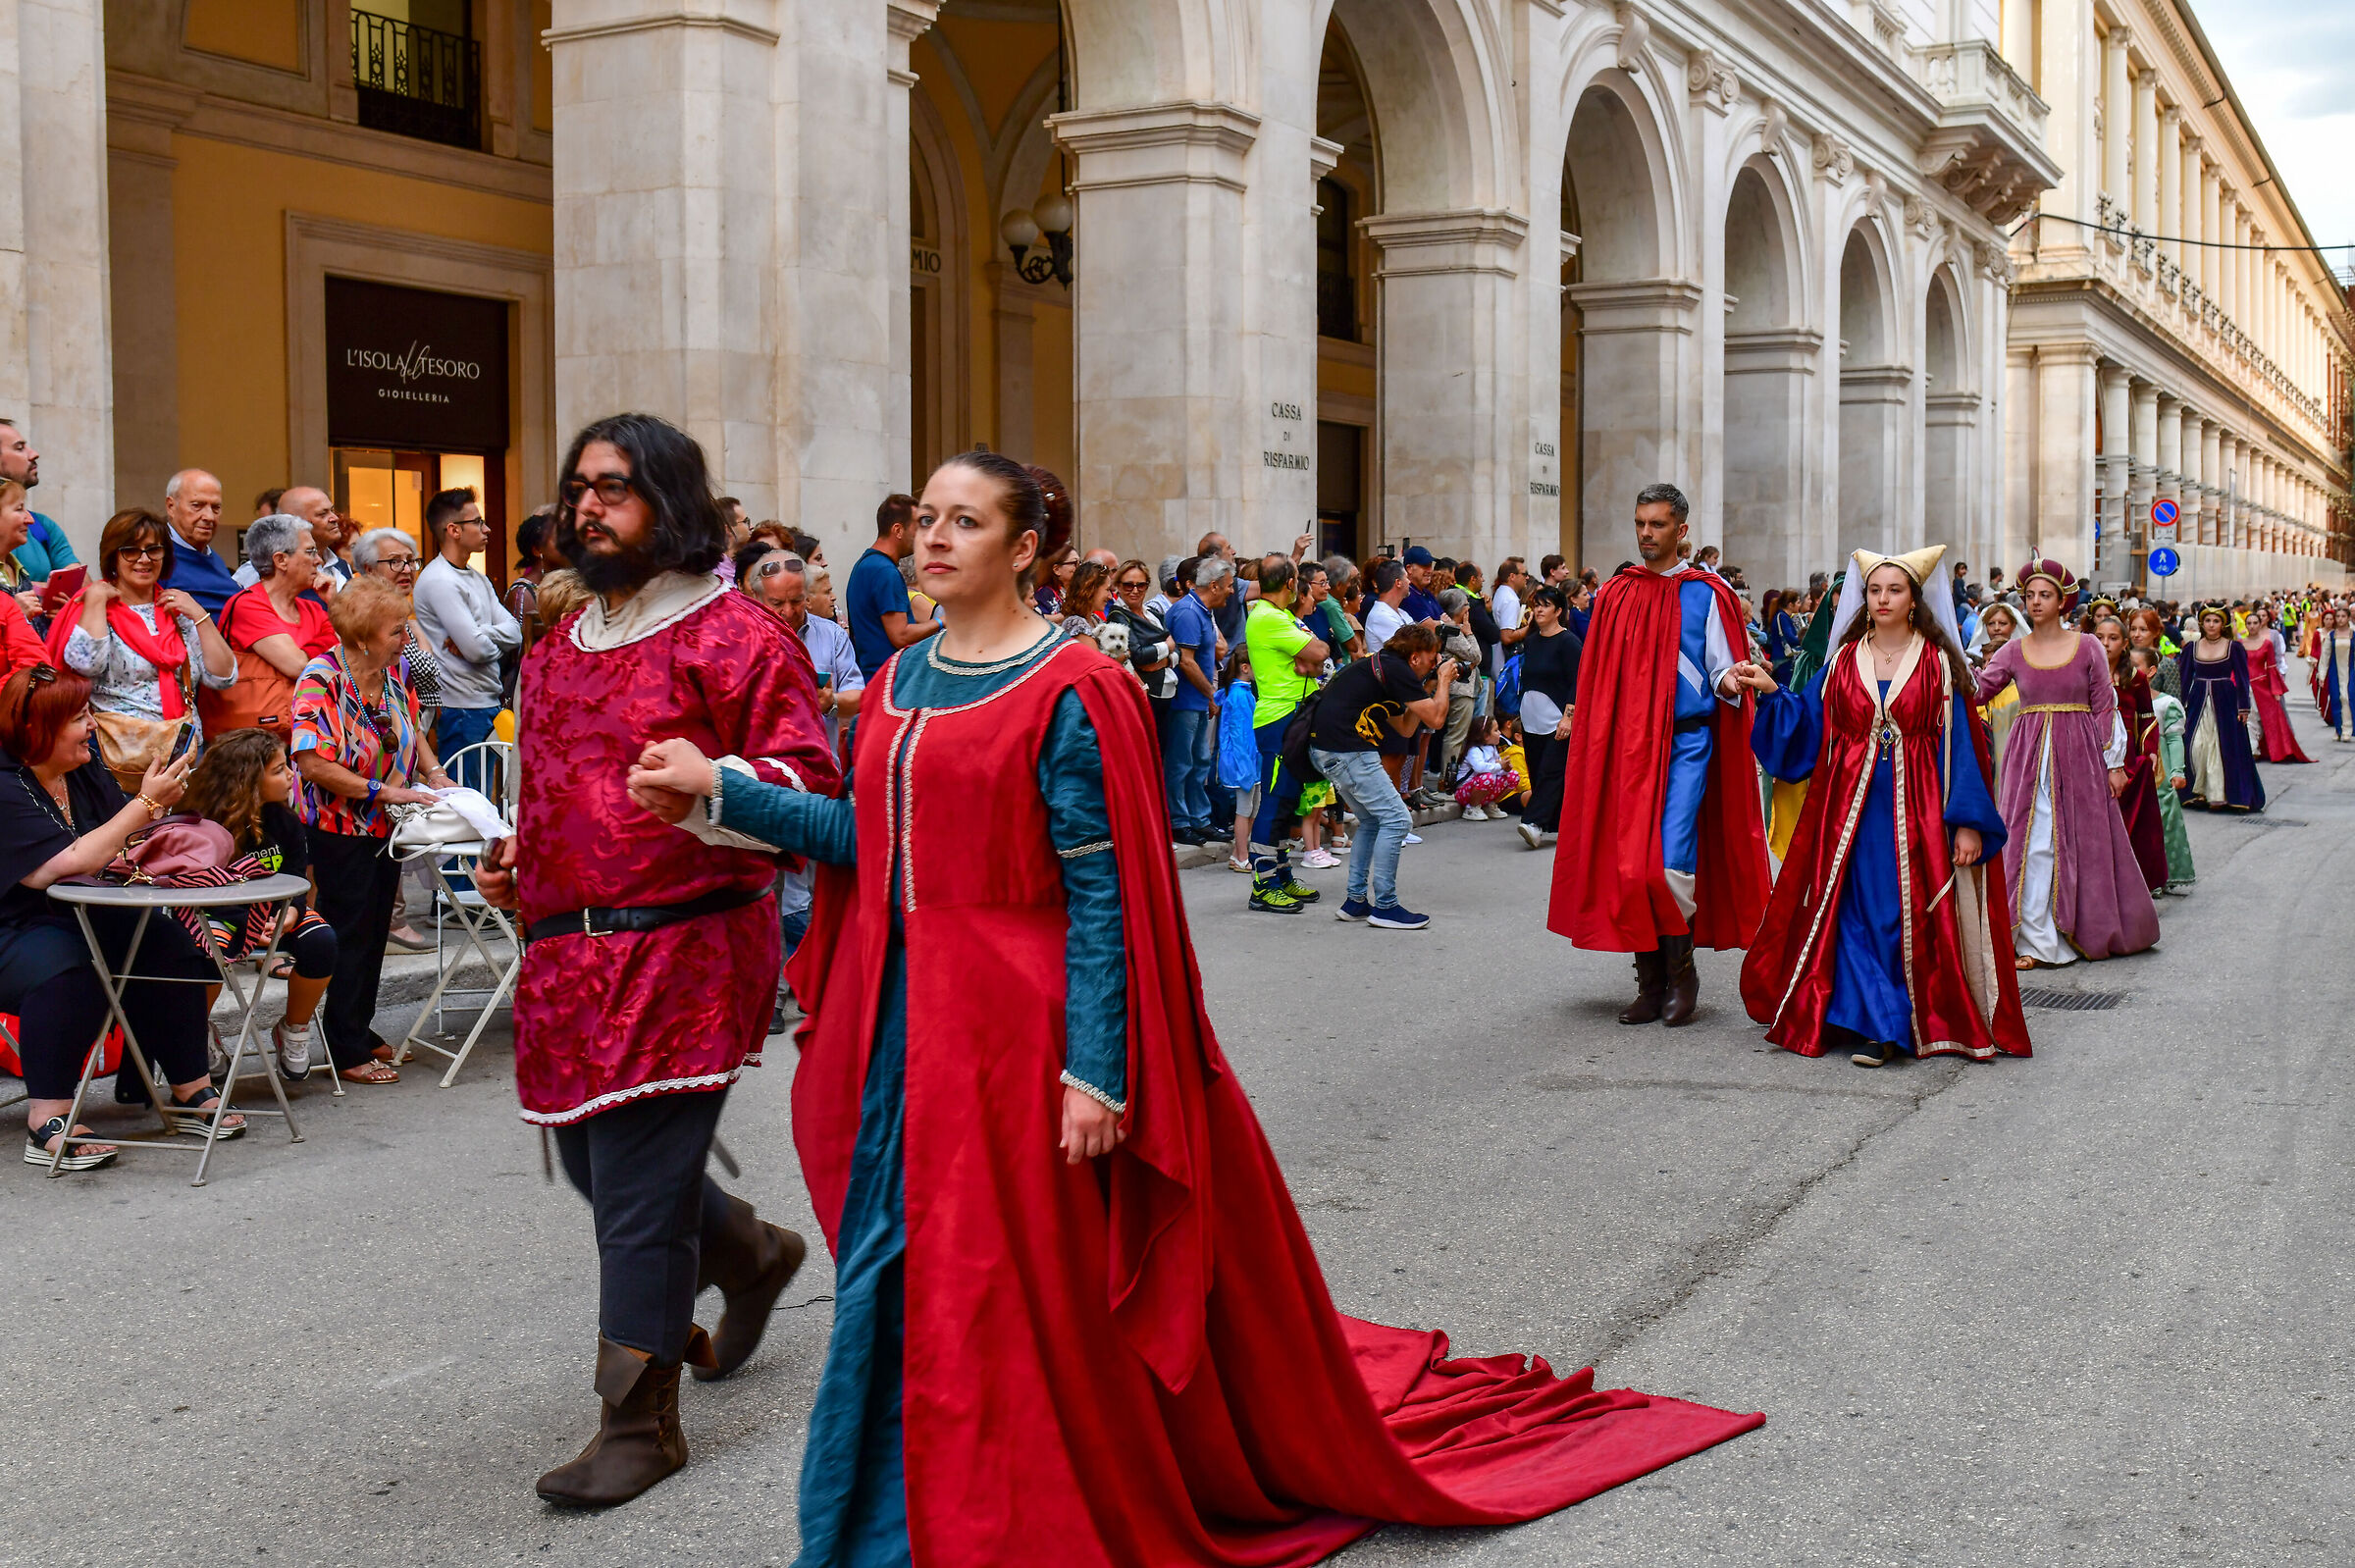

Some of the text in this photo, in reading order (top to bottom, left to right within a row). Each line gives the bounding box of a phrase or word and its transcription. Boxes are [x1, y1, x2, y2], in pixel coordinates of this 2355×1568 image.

[347, 340, 480, 384] L'ISOLA del TESORO
[378, 389, 450, 403] GIOIELLERIA
[1272, 402, 1302, 421] CASSA
[1283, 431, 1290, 442] DI
[1535, 442, 1555, 457] CASSA
[1264, 451, 1310, 471] RISPARMIO
[1530, 482, 1560, 497] RISPARMIO
[245, 844, 282, 860] ment
